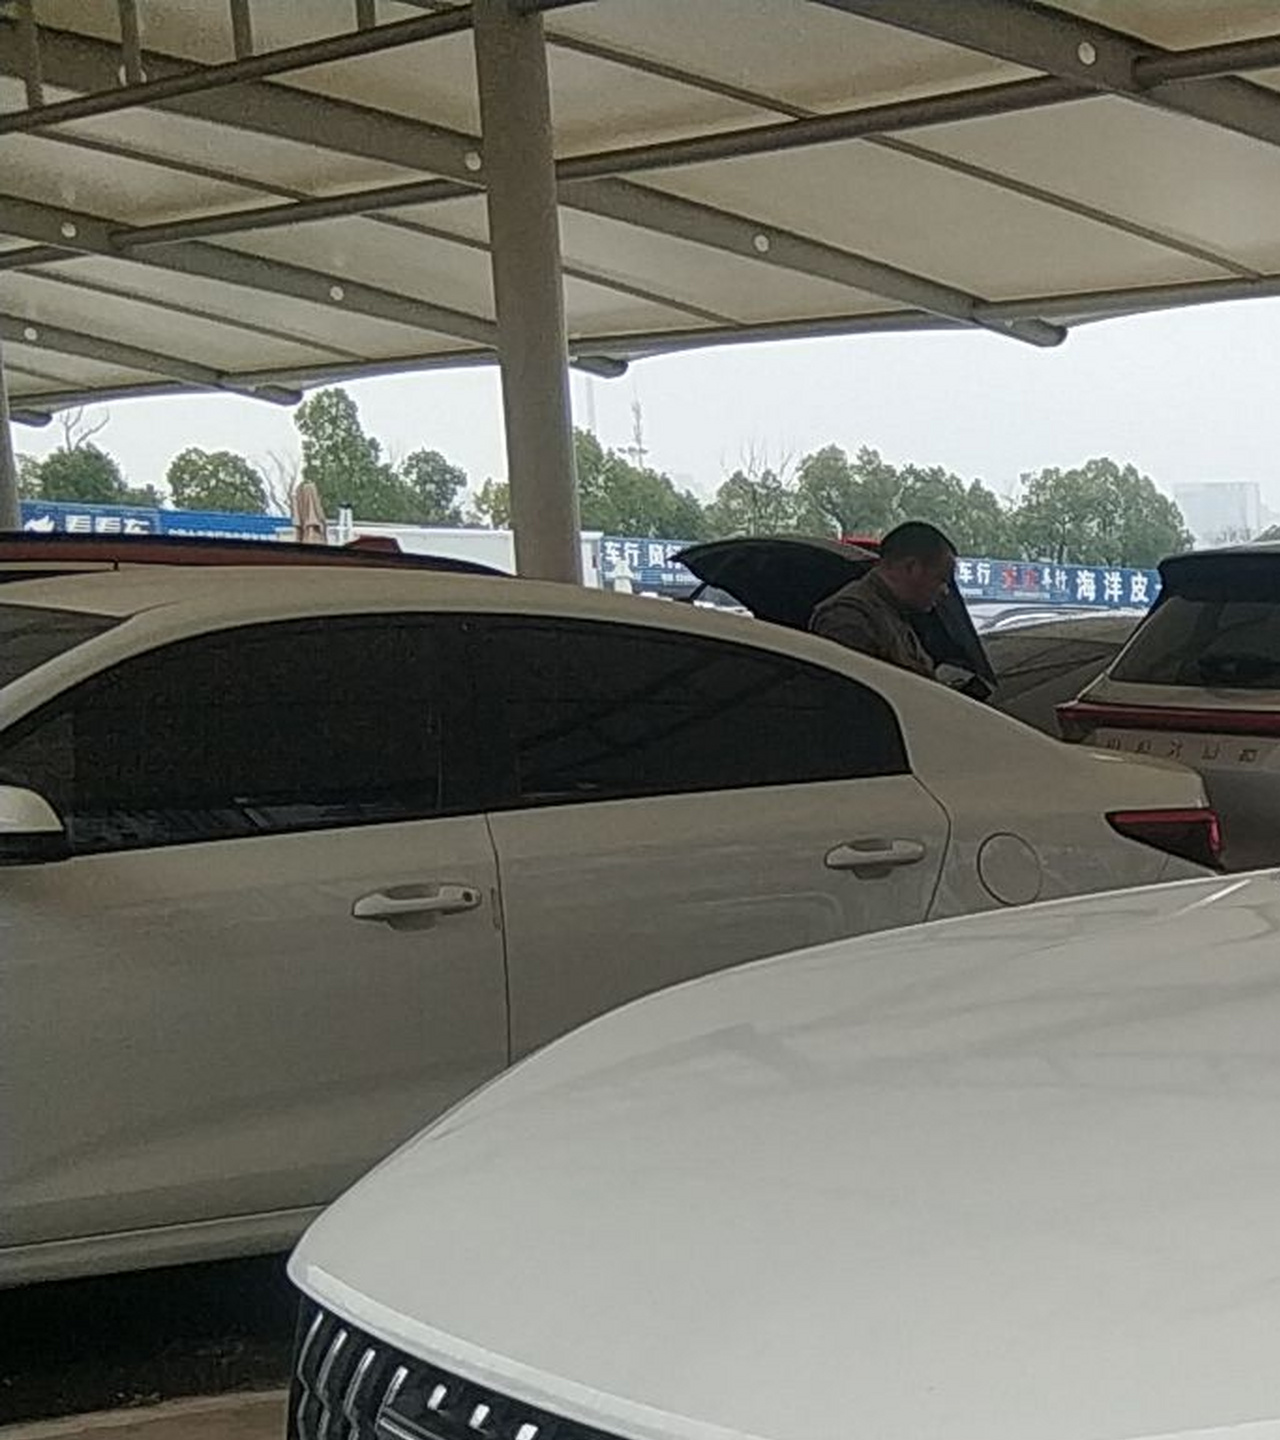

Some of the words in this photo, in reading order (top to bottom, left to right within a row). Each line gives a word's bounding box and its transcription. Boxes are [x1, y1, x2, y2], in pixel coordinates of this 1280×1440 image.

[958, 561, 991, 585] 车行
[1076, 570, 1163, 602] 海洋皮
